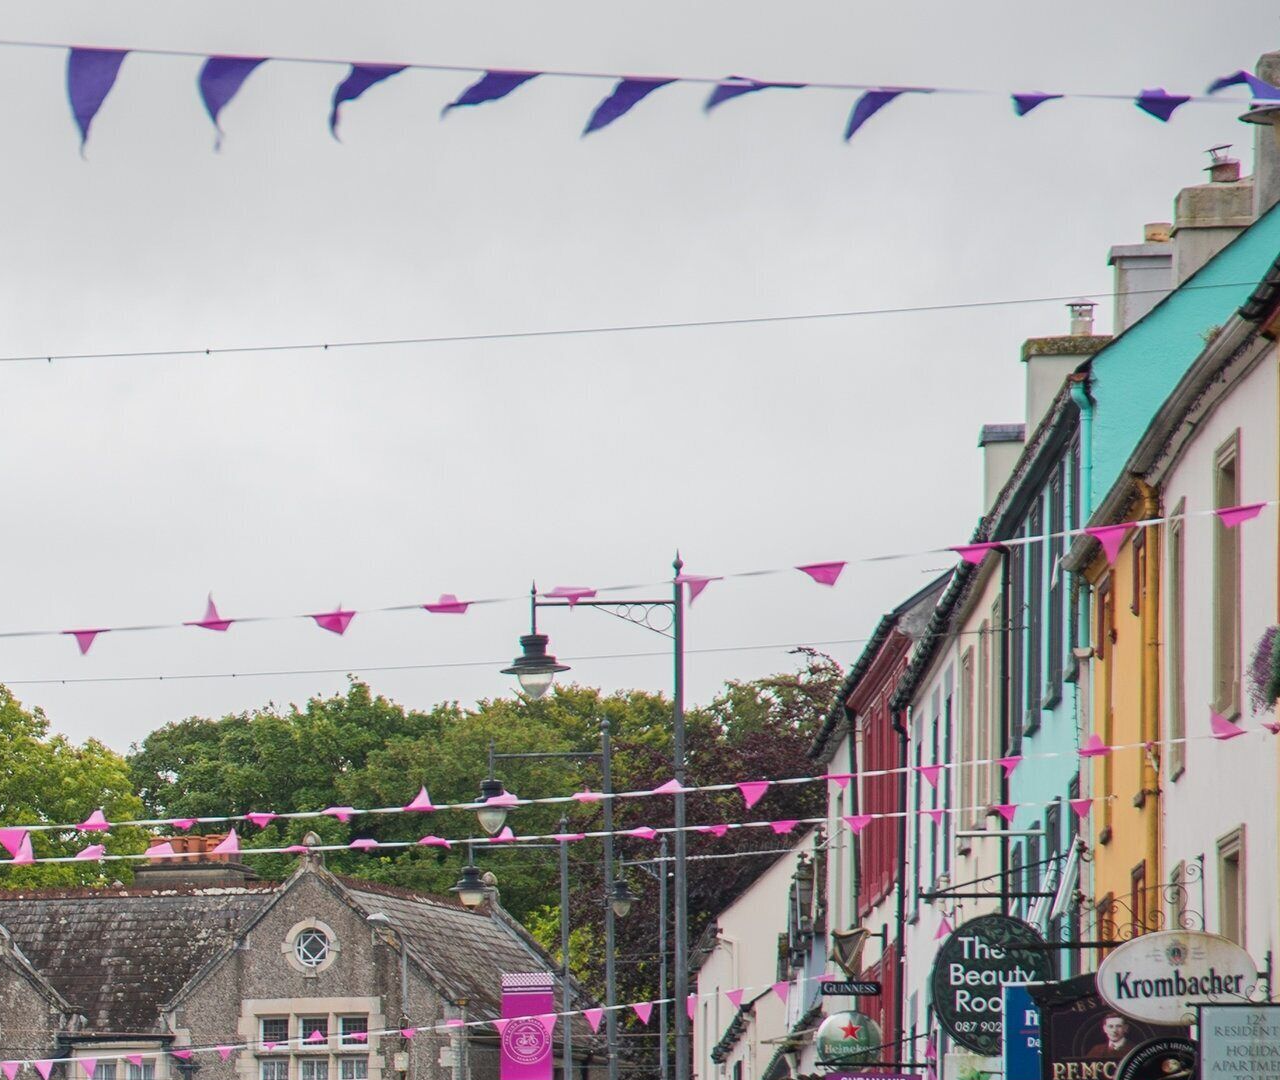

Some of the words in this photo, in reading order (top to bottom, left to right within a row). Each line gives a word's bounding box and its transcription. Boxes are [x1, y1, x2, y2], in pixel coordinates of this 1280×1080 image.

[958, 936, 1006, 959] The
[949, 963, 1036, 986] Beauty
[1115, 966, 1244, 999] Krombacher
[823, 983, 877, 993] GUINNESS
[956, 989, 1003, 1013] Roo
[955, 1021, 977, 1032] 087
[980, 1021, 1002, 1032] 902
[1214, 1015, 1280, 1038] RESIDENT
[1226, 1044, 1280, 1058] HOLIDA
[1212, 1060, 1280, 1073] APARTMEN
